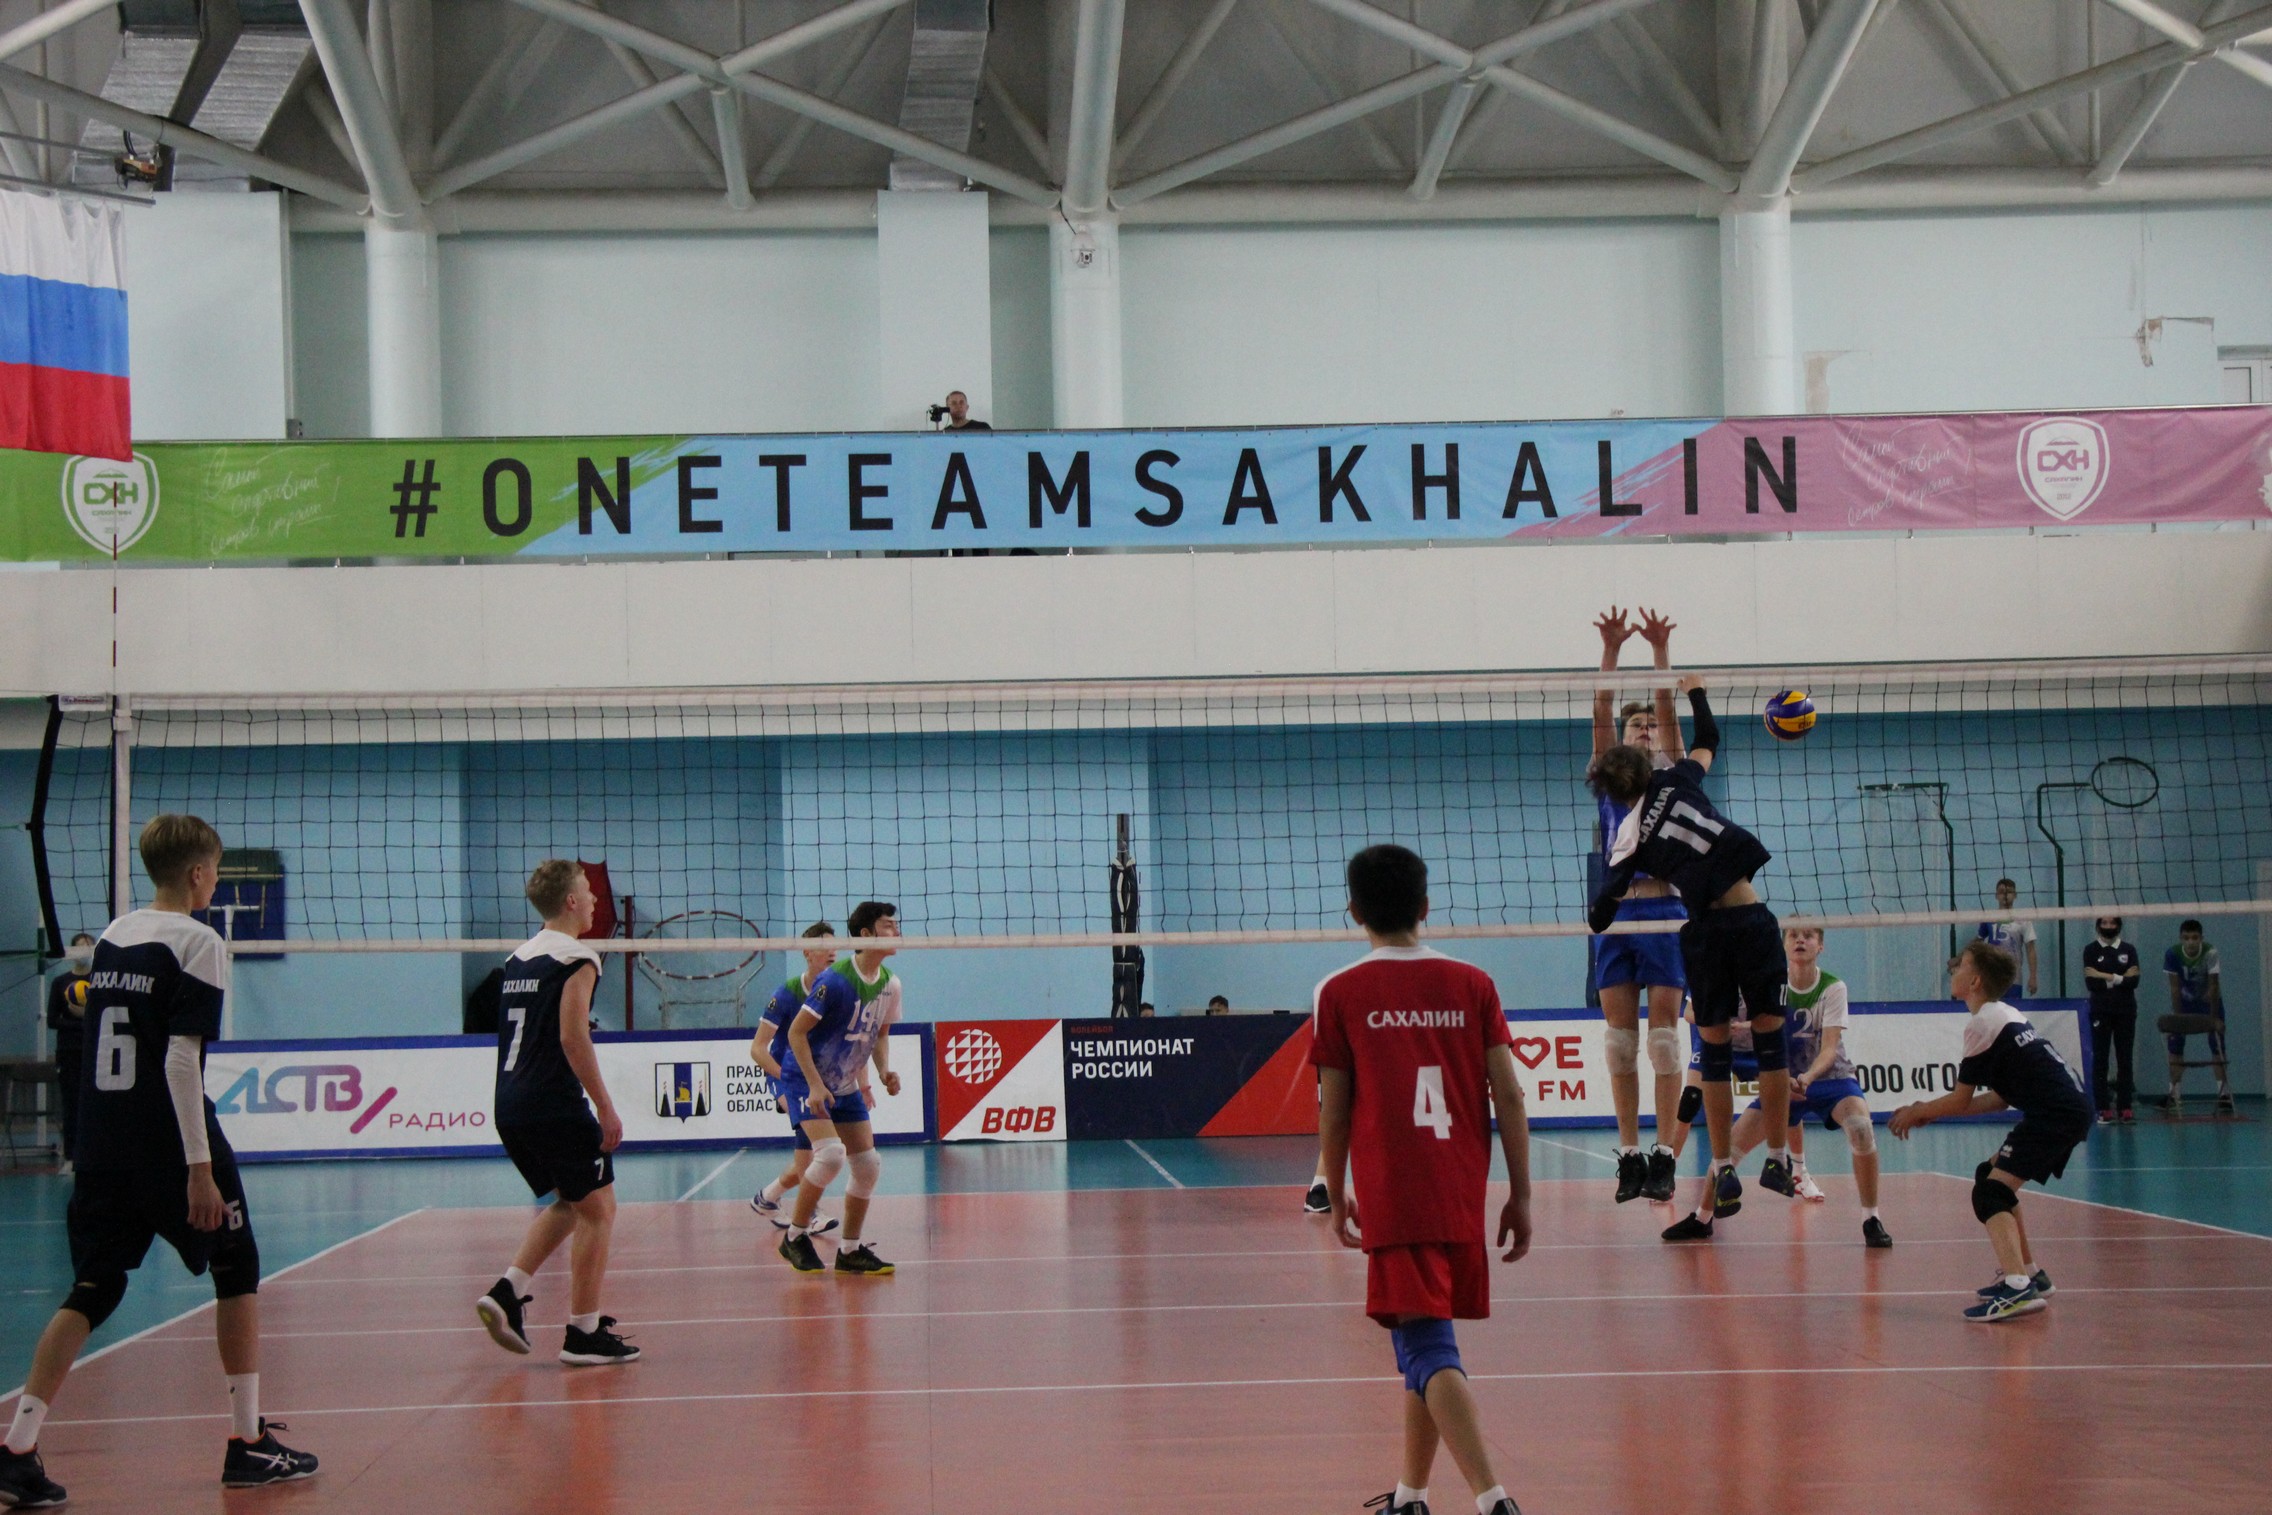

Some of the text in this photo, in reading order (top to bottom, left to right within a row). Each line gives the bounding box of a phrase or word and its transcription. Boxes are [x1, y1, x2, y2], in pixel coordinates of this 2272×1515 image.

[1658, 800, 1725, 855] 11
[90, 970, 155, 994] АХАЛИН
[1367, 1010, 1465, 1029] САХАЛИН
[95, 1006, 137, 1091] 6
[504, 1007, 526, 1072] 7
[1070, 1038, 1195, 1058] ЧЕМПИОНАТ
[726, 1065, 767, 1079] ПРАВ
[1071, 1061, 1153, 1079] РОССИИ
[1538, 1080, 1586, 1101] FM
[1413, 1066, 1453, 1140] 4
[389, 1111, 486, 1131] РАДИО
[981, 1105, 1056, 1134] ВФВ
[594, 1158, 604, 1180] 7
